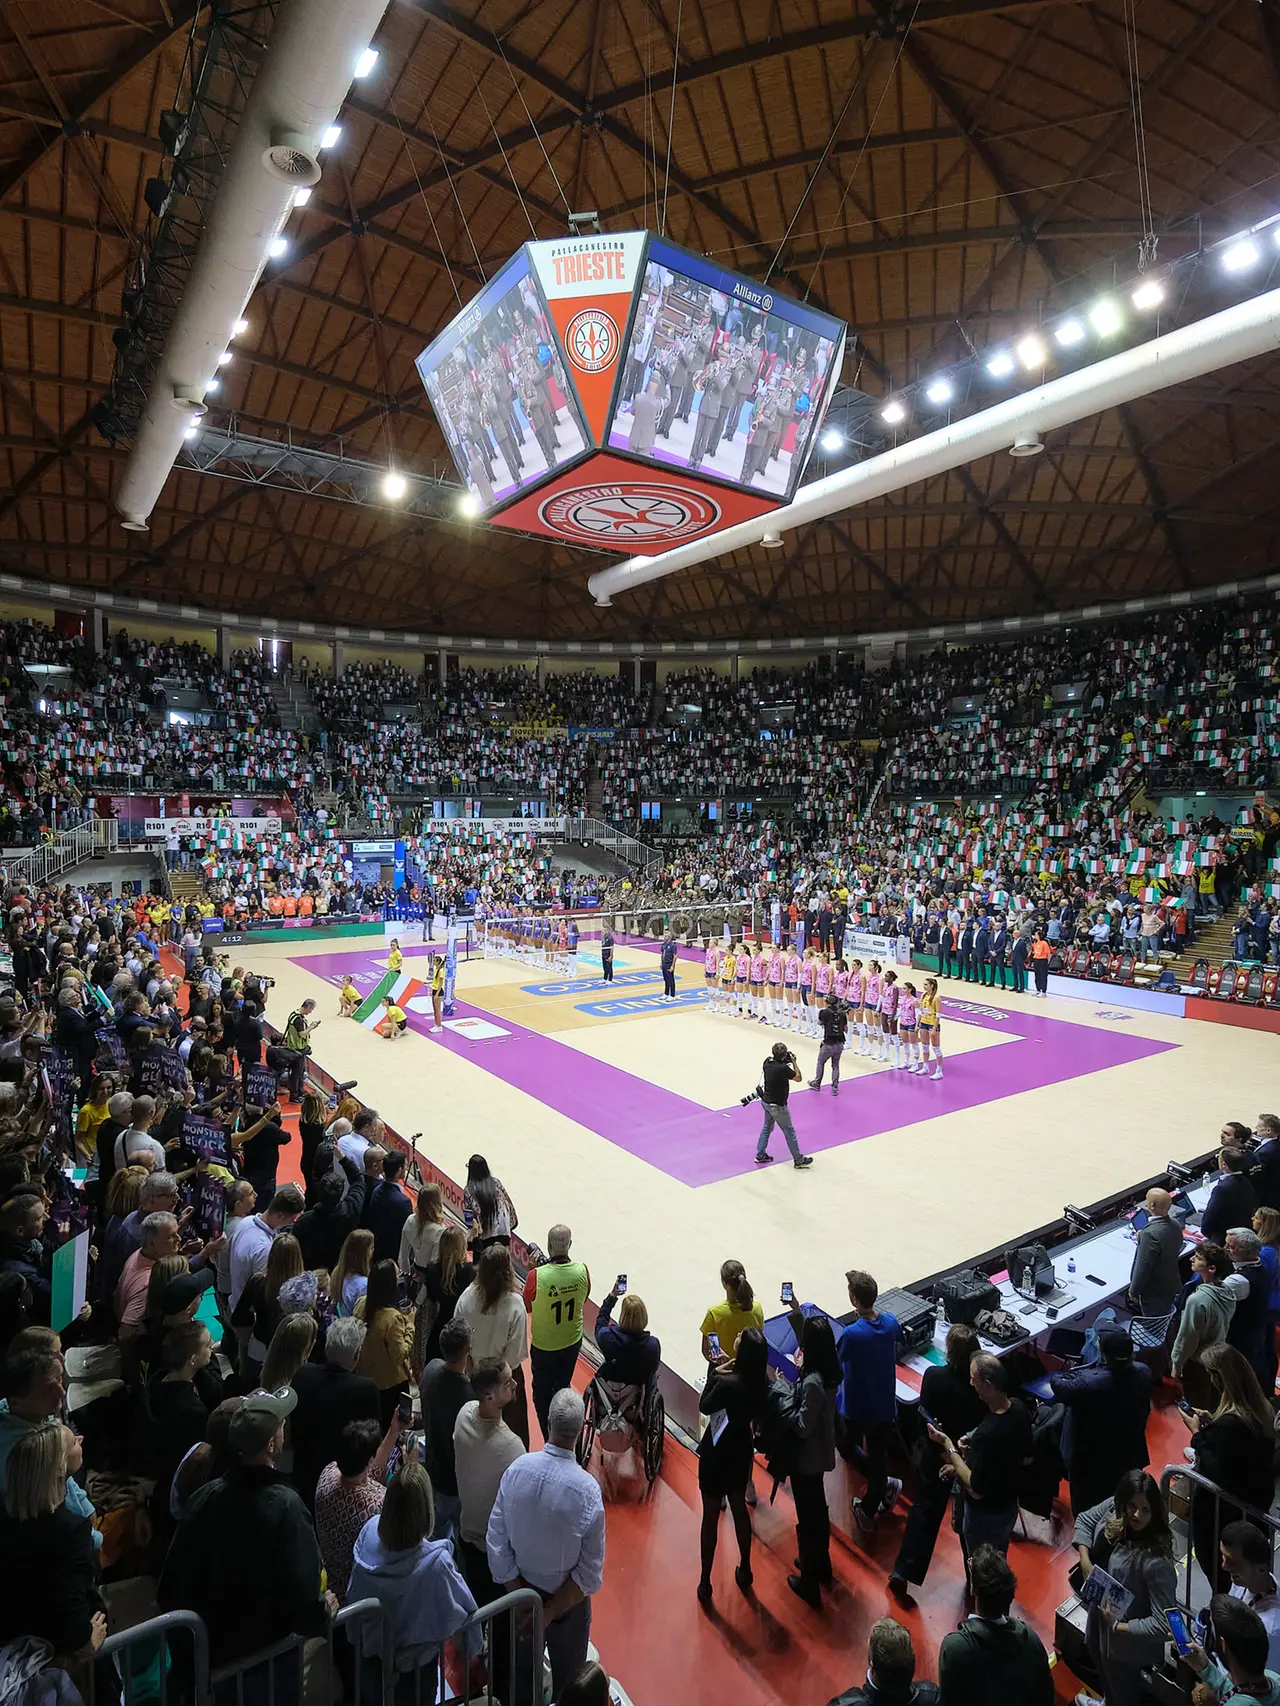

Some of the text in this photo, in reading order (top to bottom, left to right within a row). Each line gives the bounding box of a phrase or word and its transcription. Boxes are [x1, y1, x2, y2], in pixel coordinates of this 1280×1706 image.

[552, 242, 625, 257] PALLACANESTRO
[552, 251, 626, 285] TRIESTE
[733, 282, 762, 305] Allianz
[550, 487, 623, 522] PALLACANESTRO
[662, 520, 707, 538] TRIESTE
[146, 822, 165, 830] R101
[247, 1084, 276, 1099] BLOCK
[182, 1123, 226, 1140] MONSTER
[184, 1135, 227, 1153] BLOCK
[551, 1297, 575, 1325] 11
